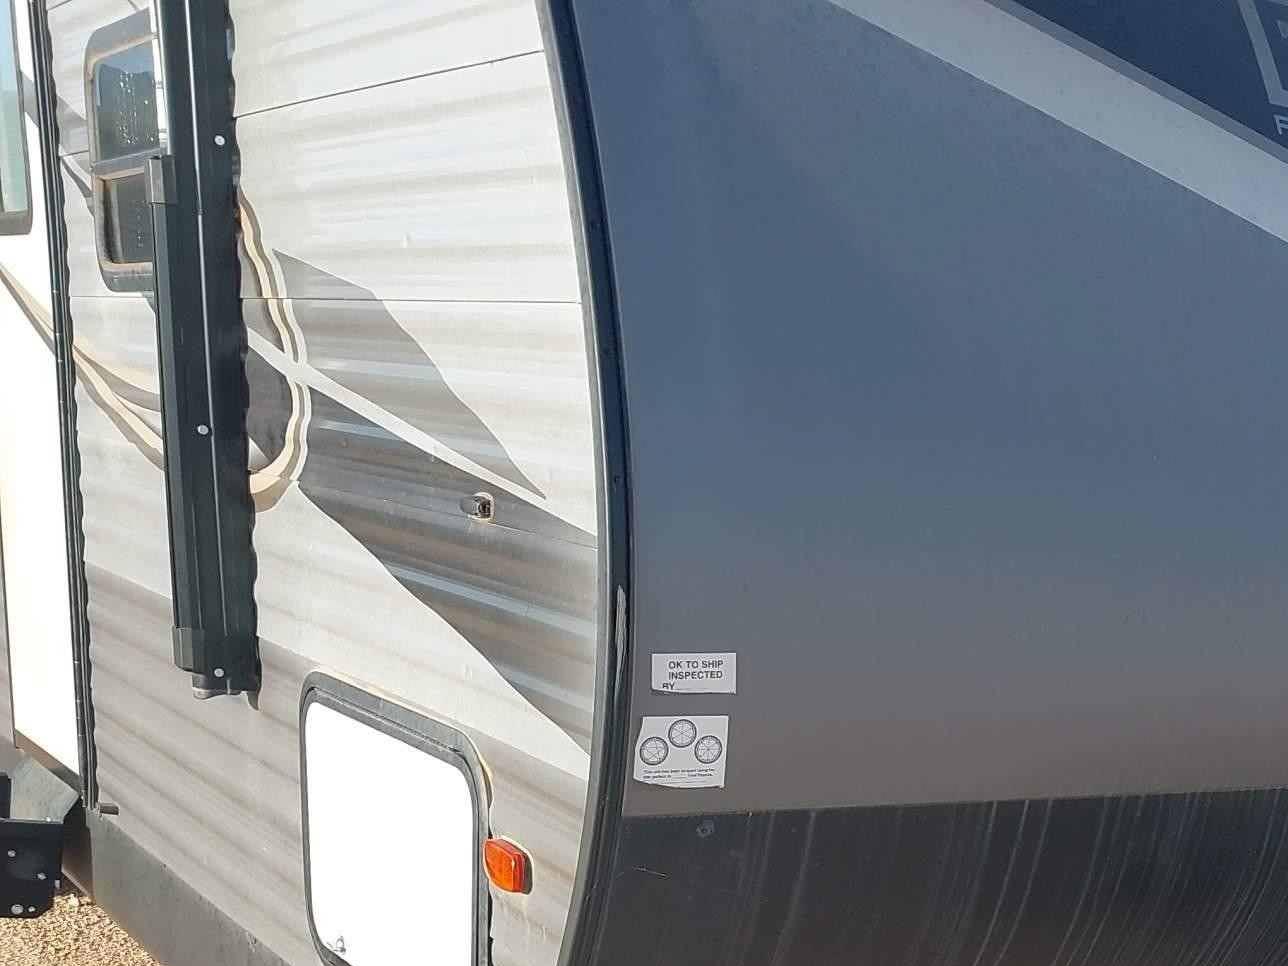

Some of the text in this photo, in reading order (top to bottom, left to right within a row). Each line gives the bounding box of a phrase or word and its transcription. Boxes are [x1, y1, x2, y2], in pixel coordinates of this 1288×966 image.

[668, 660, 724, 669] OK TO SHIP
[668, 670, 723, 680] INSPECTED
